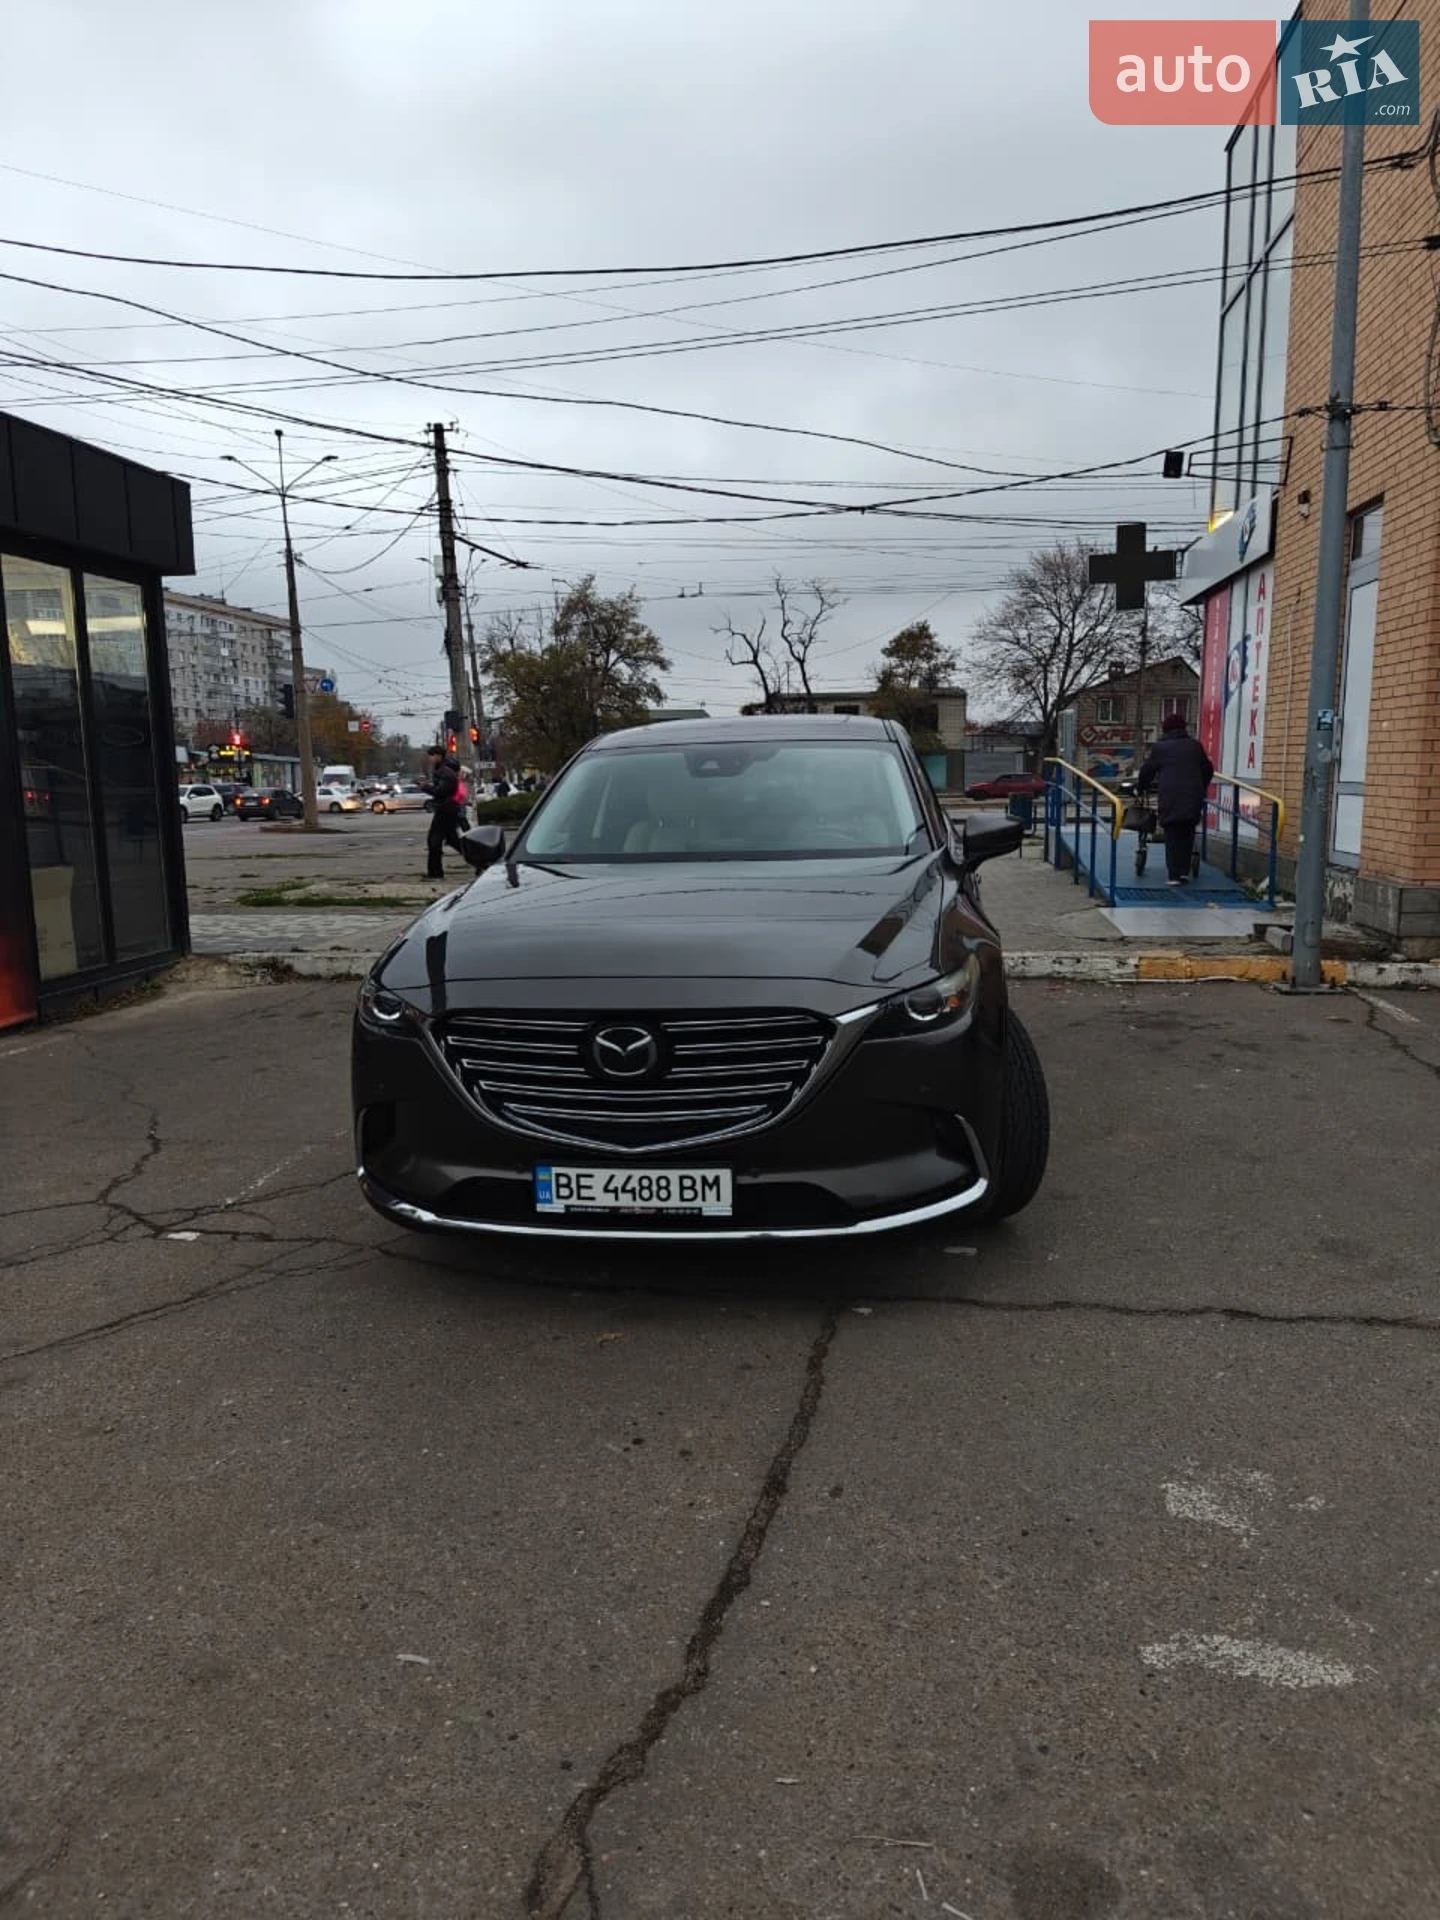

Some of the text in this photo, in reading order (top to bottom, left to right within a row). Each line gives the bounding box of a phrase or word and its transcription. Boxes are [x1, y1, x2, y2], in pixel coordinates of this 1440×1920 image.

[1247, 572, 1266, 769] АПТЕКА
[1079, 725, 1154, 745] EXPET
[539, 1190, 551, 1200] UA
[555, 1172, 721, 1203] BE 4488 BM
